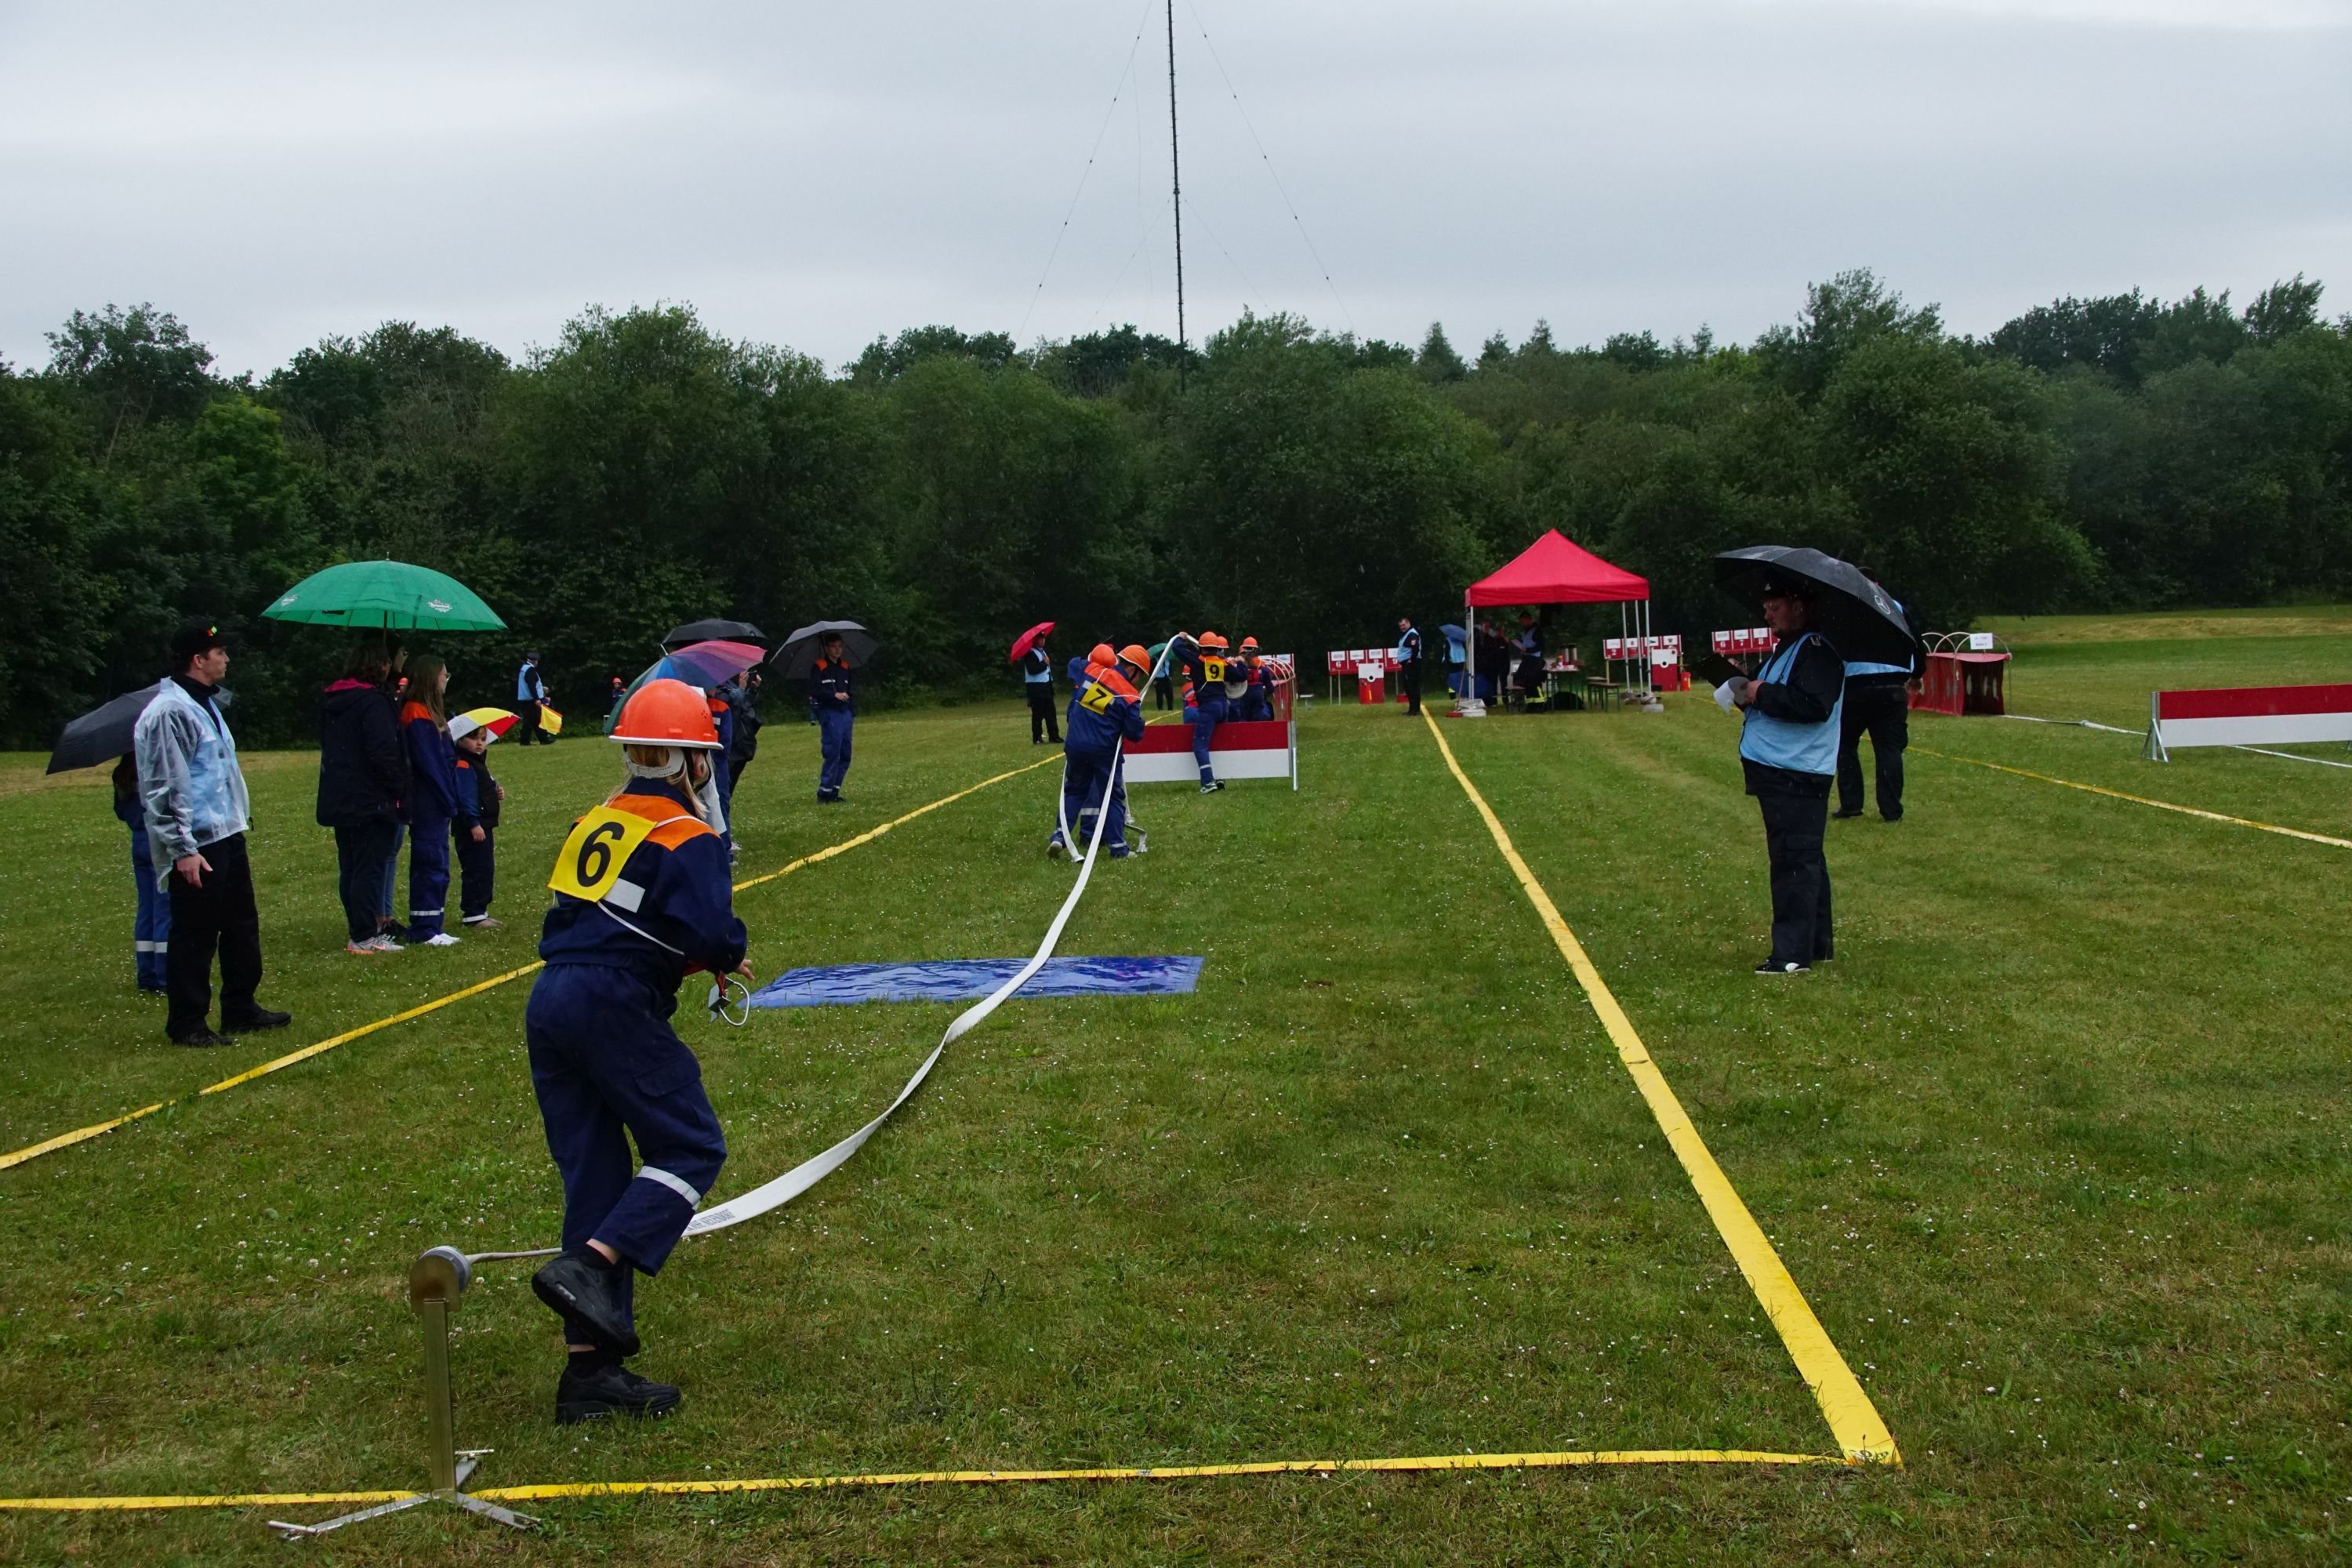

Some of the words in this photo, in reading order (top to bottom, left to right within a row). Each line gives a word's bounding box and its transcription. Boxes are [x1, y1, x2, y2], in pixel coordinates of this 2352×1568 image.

[1209, 664, 1220, 680] 9
[1088, 688, 1107, 706] 7
[577, 822, 625, 887] 6
